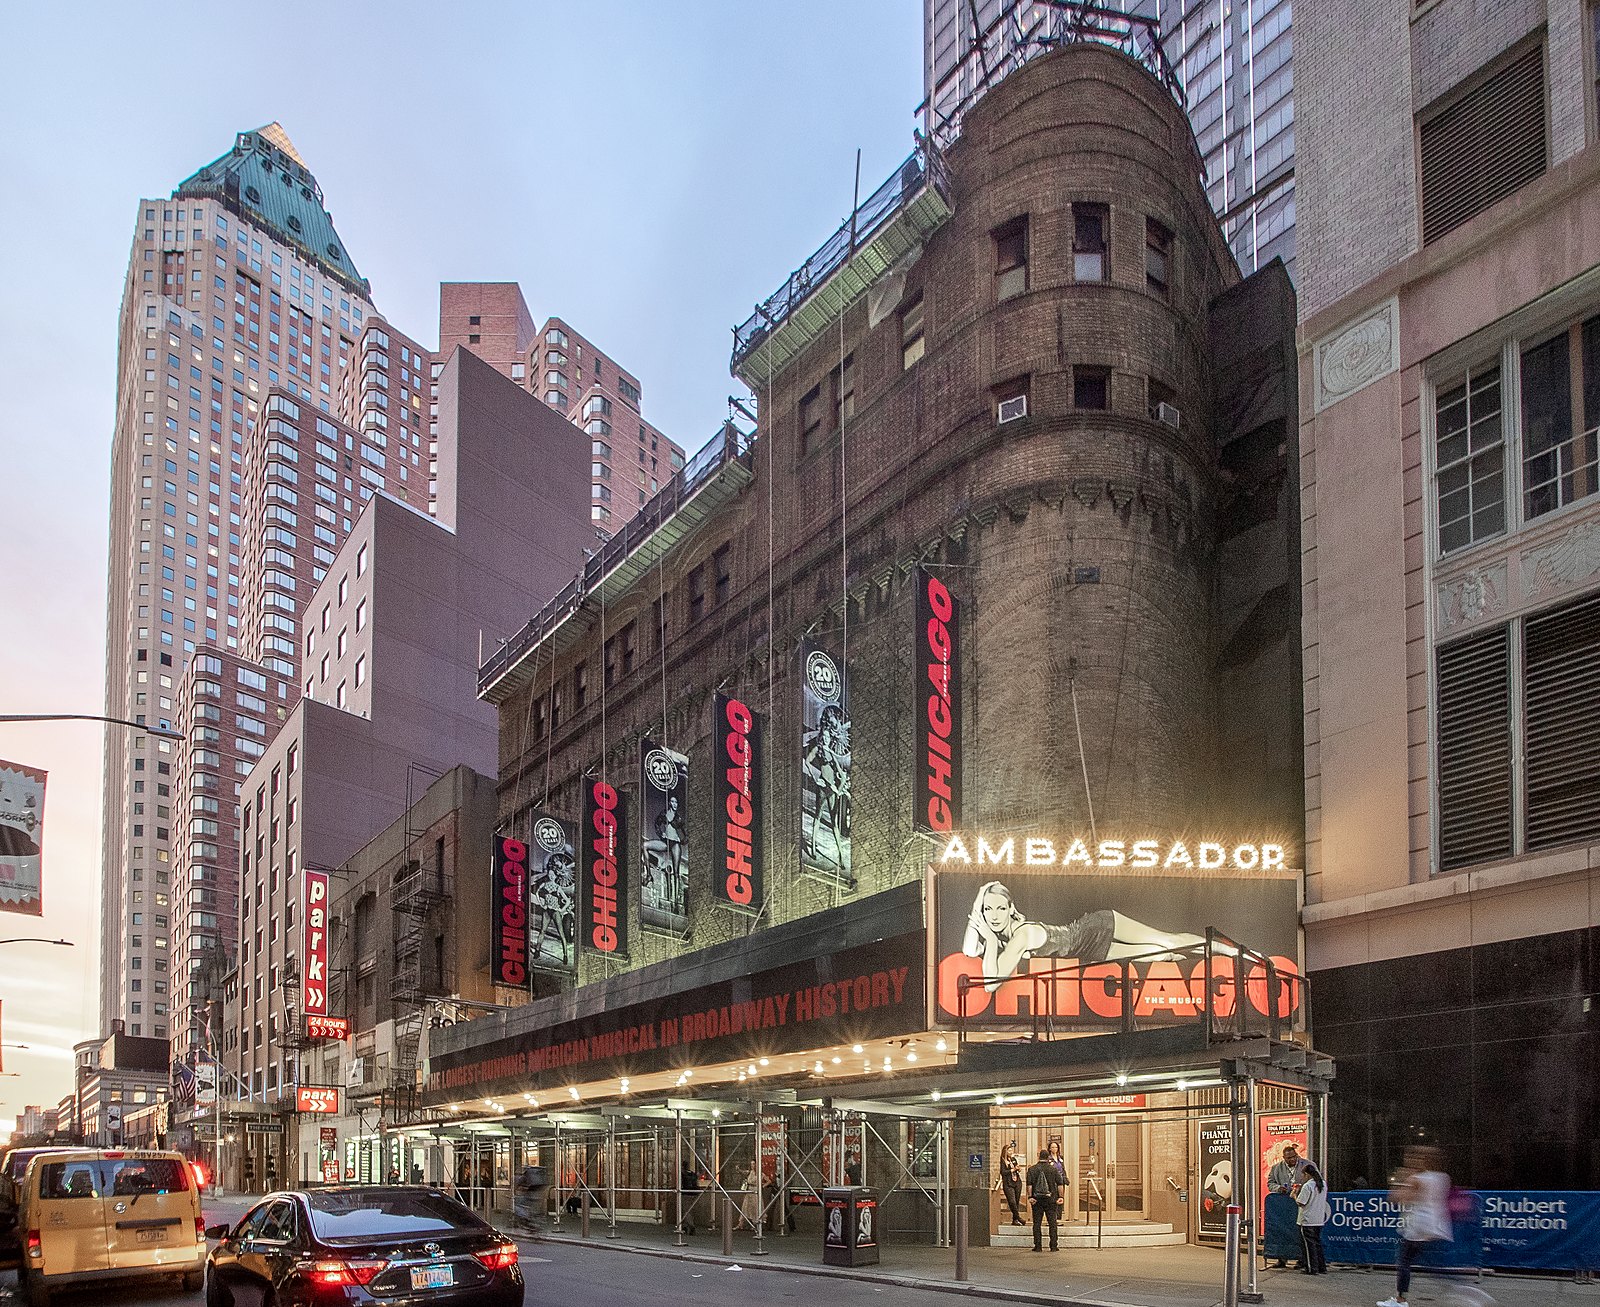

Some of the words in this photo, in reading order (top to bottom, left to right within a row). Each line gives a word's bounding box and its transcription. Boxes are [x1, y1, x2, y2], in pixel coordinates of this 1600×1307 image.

[814, 666, 832, 682] 20
[928, 577, 953, 832] CHICAGO
[653, 761, 670, 774] 20
[726, 699, 753, 906] CHICAGO
[541, 827, 558, 839] 20
[940, 835, 1285, 870] AMBASSADOR
[592, 781, 618, 952] CHICAGO
[502, 838, 526, 984] CHICAGO
[309, 879, 326, 981] park
[938, 951, 1299, 1018] CHICAGO
[1144, 996, 1165, 1004] THE
[1168, 996, 1216, 1004] MUSIC
[310, 1017, 321, 1026] 24
[323, 1017, 346, 1029] hours
[528, 1039, 589, 1072] AMERICAN
[591, 1022, 657, 1061] MUSICAL
[660, 1017, 679, 1048] IN
[681, 993, 790, 1044] BROADWAY
[795, 966, 909, 1022] HISTORY
[301, 1089, 335, 1101] park
[1208, 1145, 1231, 1154] OPER
[1332, 1198, 1364, 1212] The
[1485, 1197, 1567, 1213] Shubert
